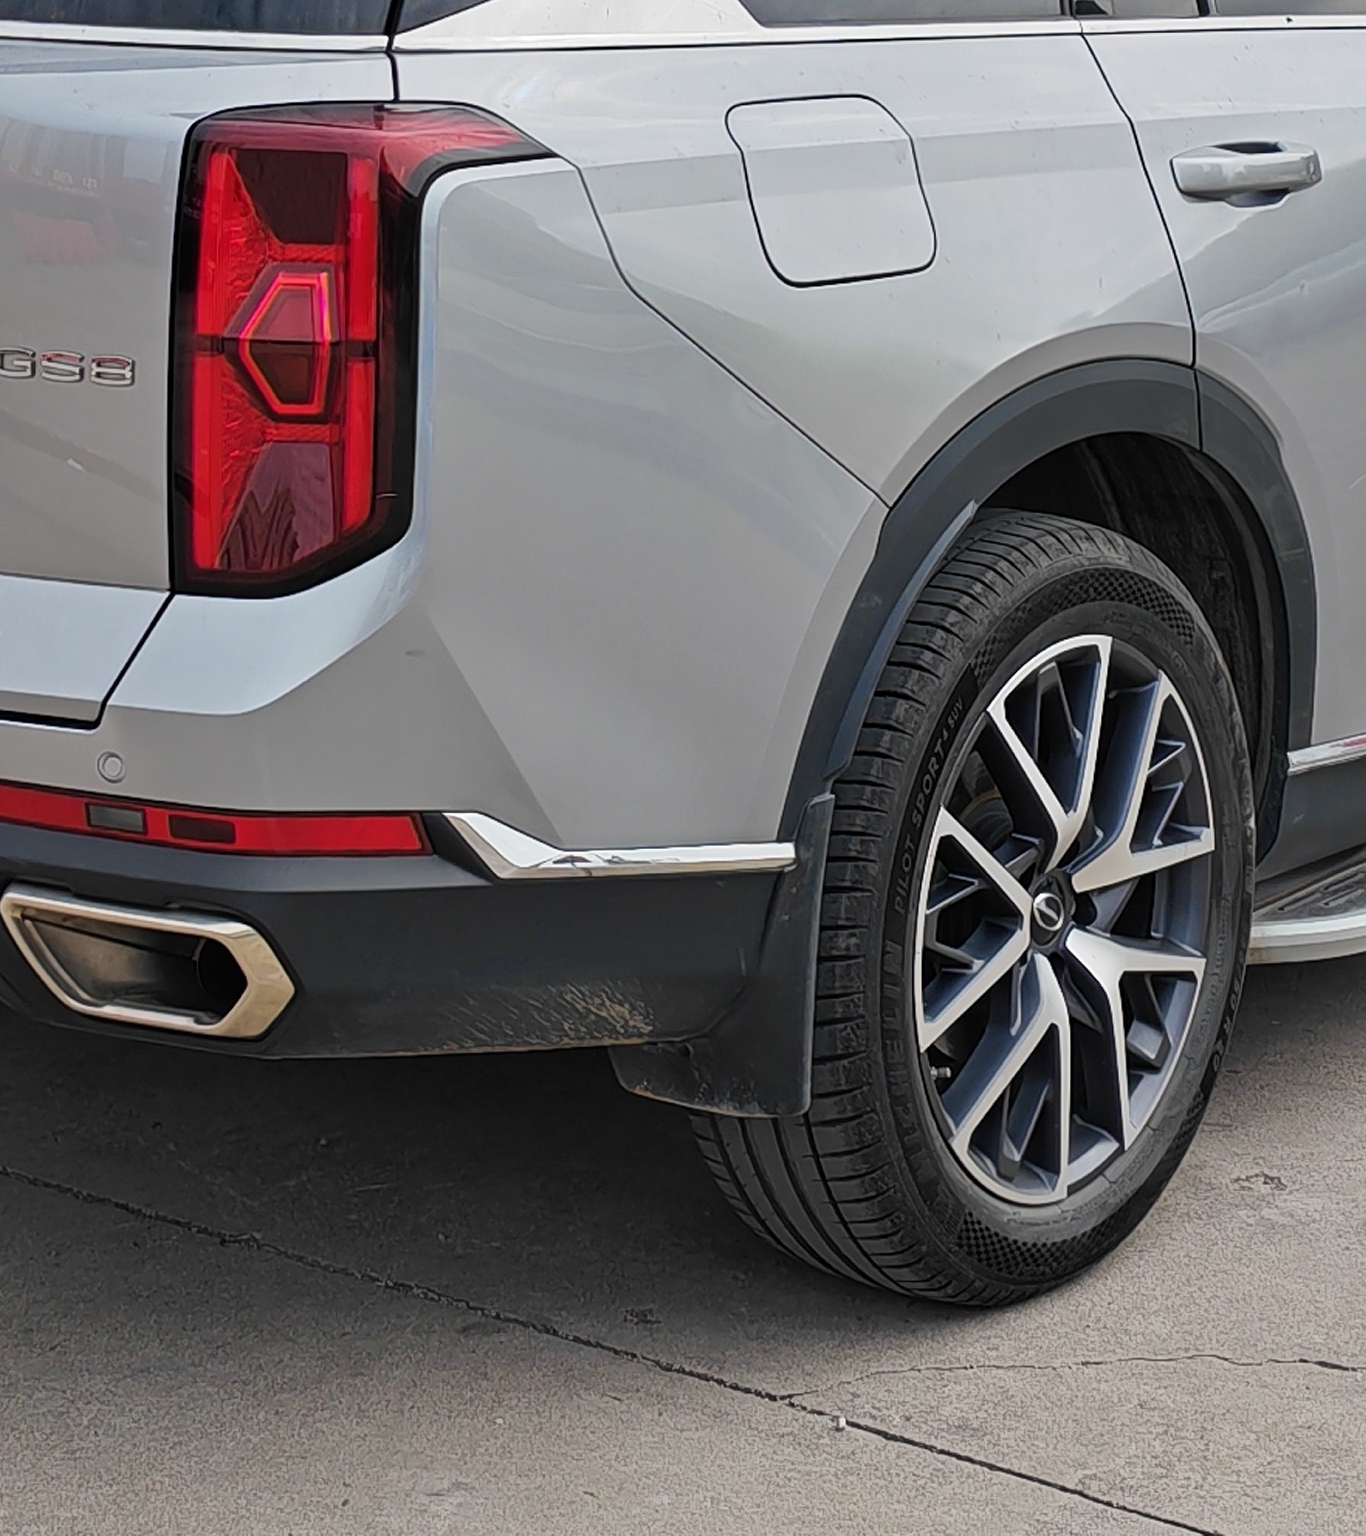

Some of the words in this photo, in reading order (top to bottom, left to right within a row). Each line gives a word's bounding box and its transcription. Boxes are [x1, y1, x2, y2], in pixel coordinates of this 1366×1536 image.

[894, 834, 917, 914] PILOT
[911, 738, 945, 829] SPORT
[947, 696, 965, 729] SUV
